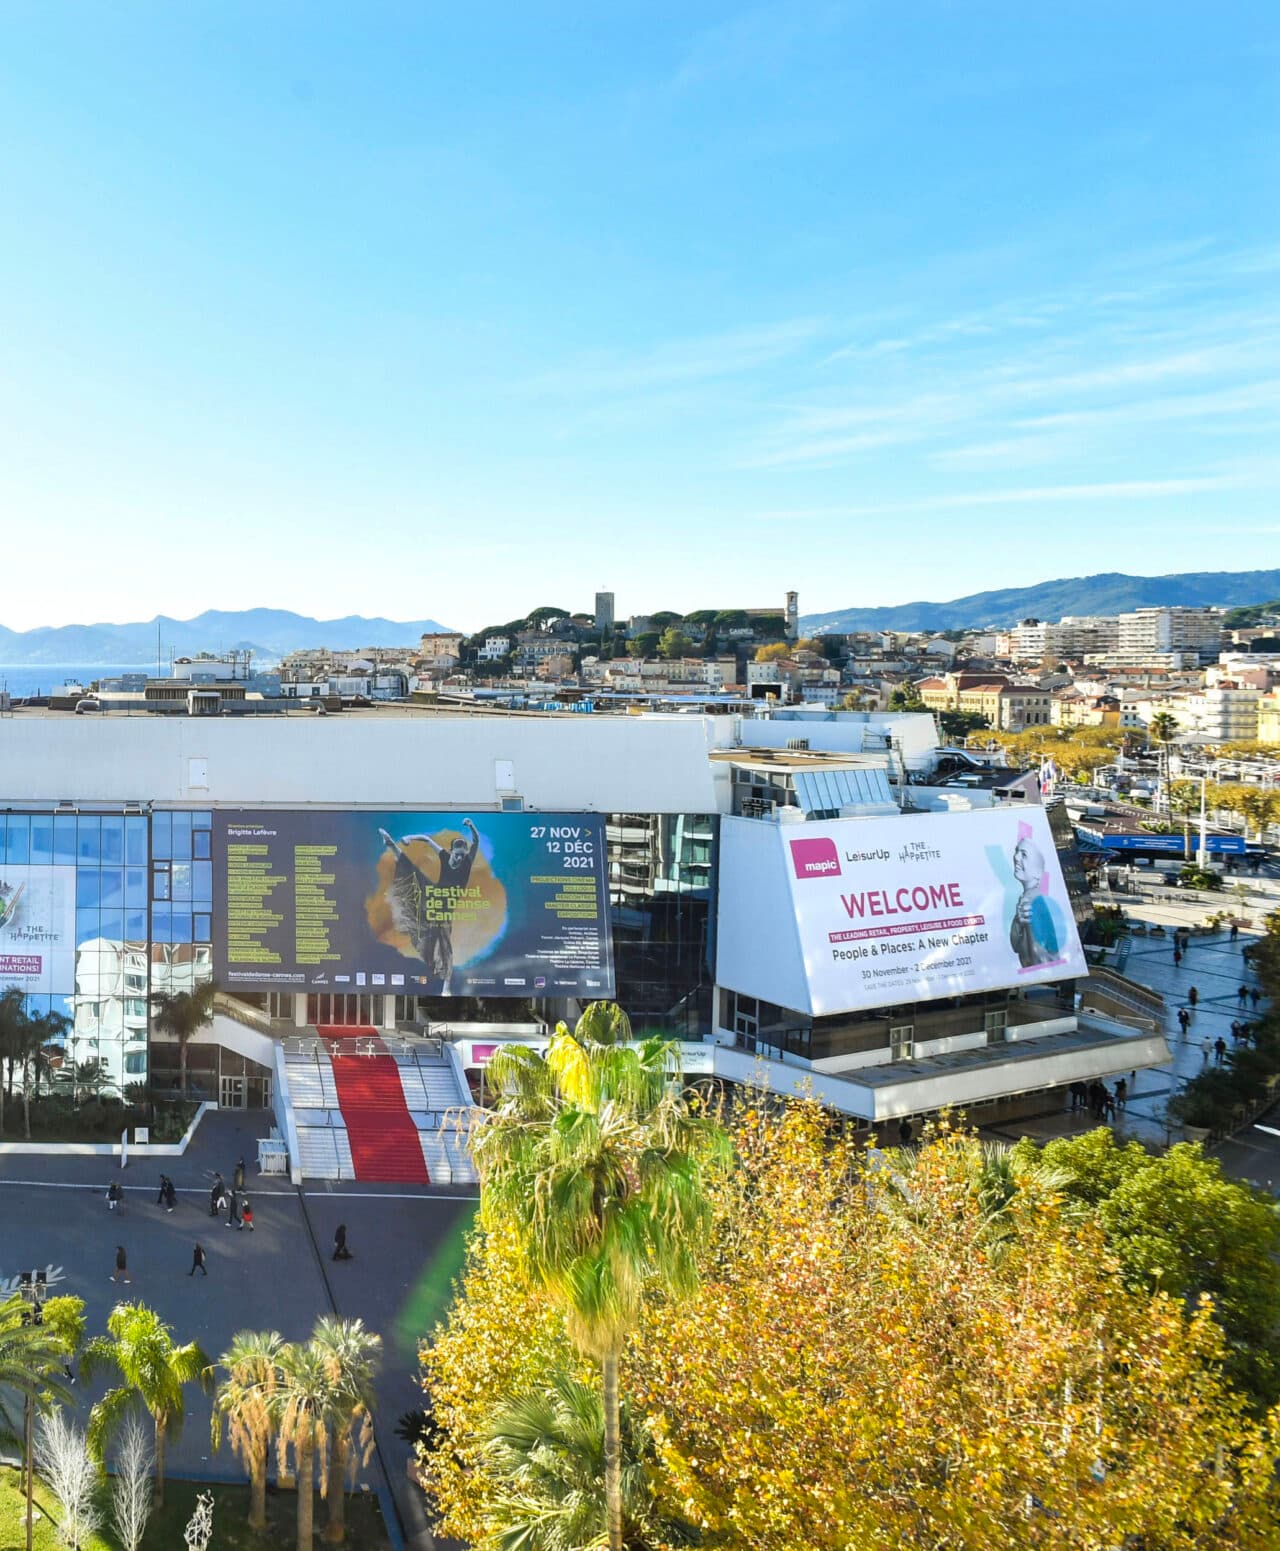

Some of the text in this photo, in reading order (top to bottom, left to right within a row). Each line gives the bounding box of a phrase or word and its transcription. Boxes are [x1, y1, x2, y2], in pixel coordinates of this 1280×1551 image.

[228, 829, 252, 837] Brigitte
[530, 827, 545, 838] 27
[550, 827, 580, 838] NOV
[546, 840, 593, 853] 12 DÉC
[910, 842, 926, 851] THE
[846, 849, 890, 862] LeisurUp
[563, 857, 594, 868] 2021
[805, 860, 837, 872] mapic
[425, 885, 481, 897] Festival
[426, 897, 490, 909] de Danse
[840, 883, 964, 919] WELCOME
[426, 909, 477, 921] Cannes
[26, 926, 44, 934] THE
[830, 933, 843, 941] THE
[843, 931, 868, 940] LEADING
[890, 925, 920, 934] PROPERTY,
[948, 919, 963, 927] FOOD
[832, 932, 989, 961] People & Places: A New Chapter
[862, 969, 872, 980] 30
[872, 966, 909, 978] November
[915, 963, 920, 972] 2
[956, 956, 972, 966] 2021
